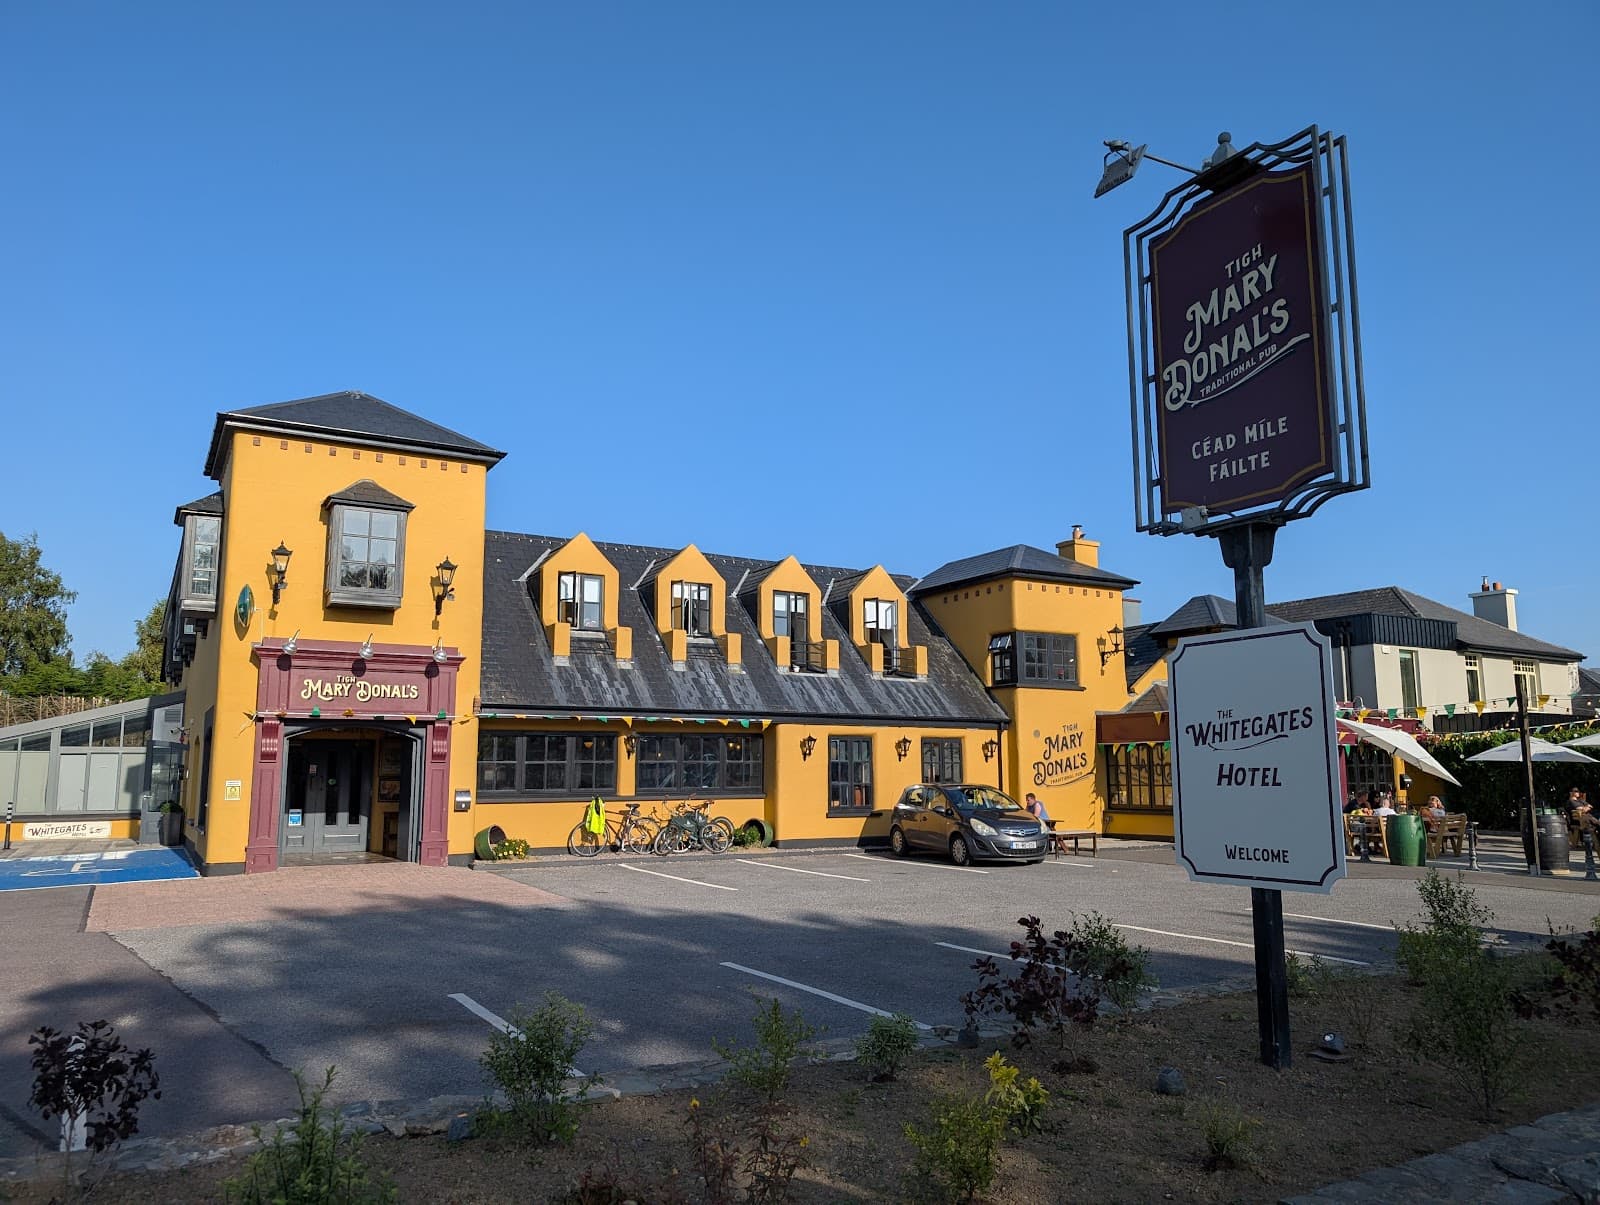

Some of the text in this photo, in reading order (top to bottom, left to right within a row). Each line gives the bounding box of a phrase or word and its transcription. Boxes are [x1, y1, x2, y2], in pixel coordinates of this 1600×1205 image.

[1225, 243, 1262, 279] TIGH
[1184, 254, 1277, 353] MARY
[1163, 298, 1289, 411] DONAL'S
[1200, 344, 1277, 397] TRADITIONAL PUB
[1191, 416, 1288, 460] CÉAD MÍLE
[1209, 451, 1270, 482] FÁILTE
[301, 679, 418, 702] MARY DONAL'S
[337, 675, 355, 683] TIGH
[1185, 706, 1313, 747] WHITEGATES
[1217, 709, 1233, 719] THE
[1043, 731, 1083, 760] MARY
[1033, 752, 1087, 786] DONAL'S
[1216, 763, 1282, 787] HOTEL
[28, 824, 87, 836] WHITEGATES
[1225, 844, 1289, 864] WELCOME
